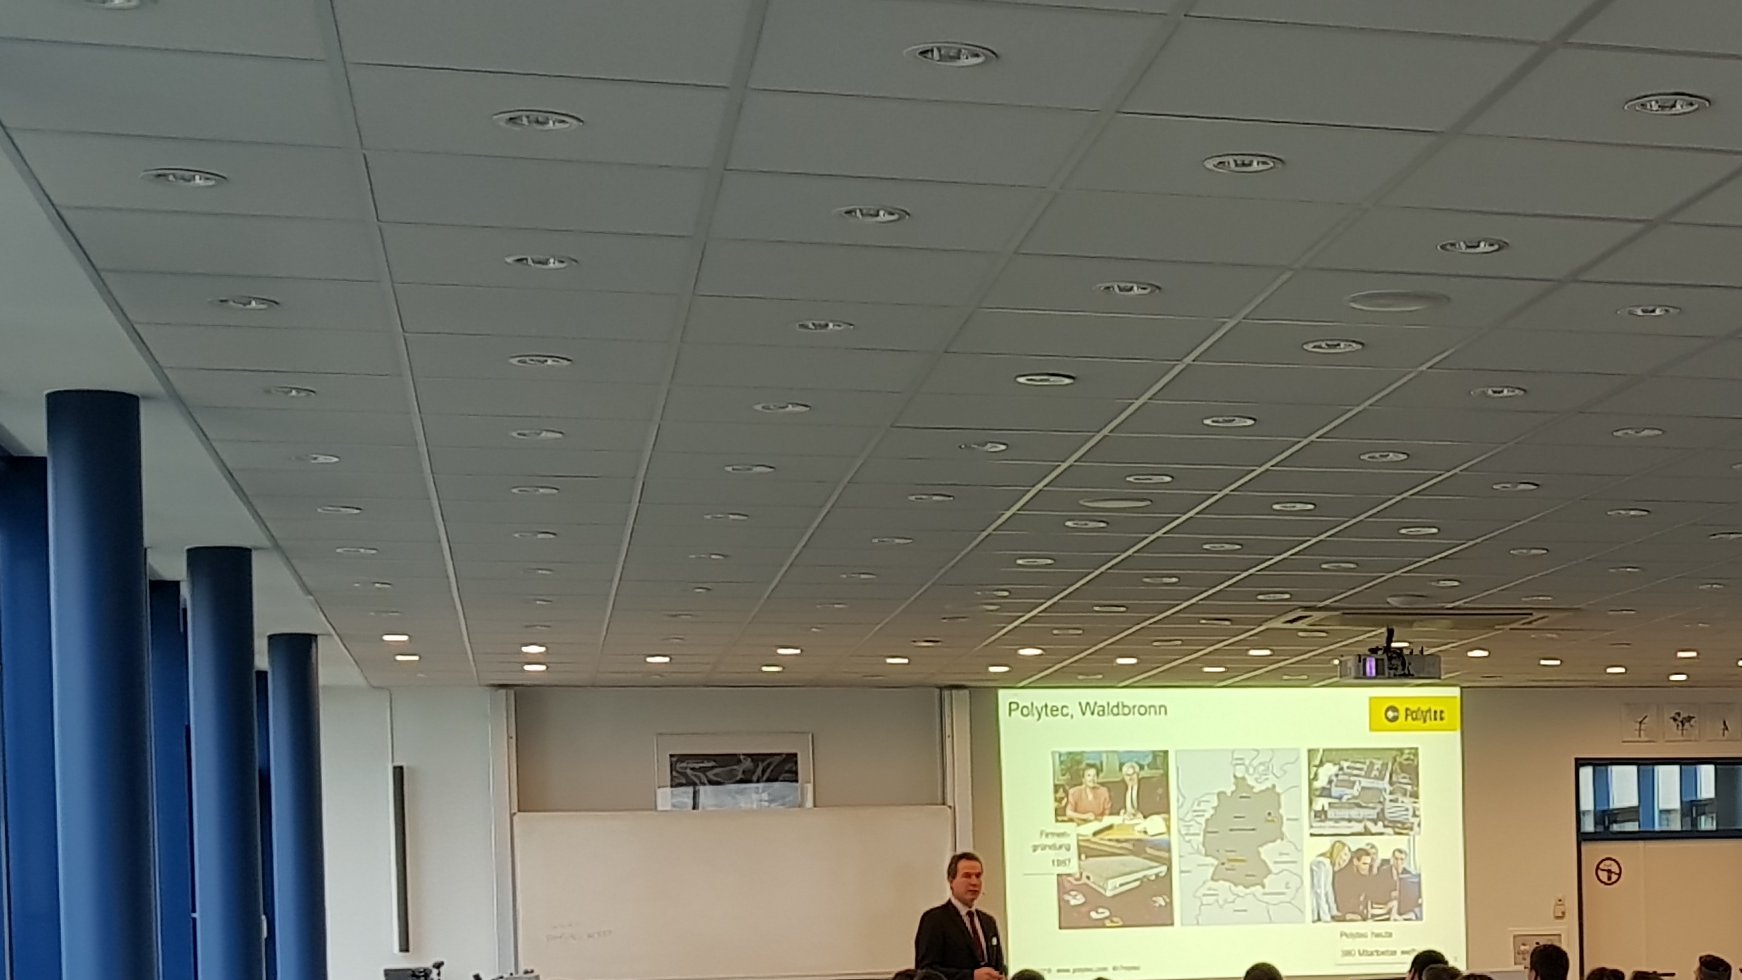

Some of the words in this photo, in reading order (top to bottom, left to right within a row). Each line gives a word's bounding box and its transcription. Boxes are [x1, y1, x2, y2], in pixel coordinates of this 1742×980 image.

[1008, 700, 1075, 722] Polytec,
[1078, 700, 1168, 717] Waldbronn
[1404, 706, 1446, 724] Polytec
